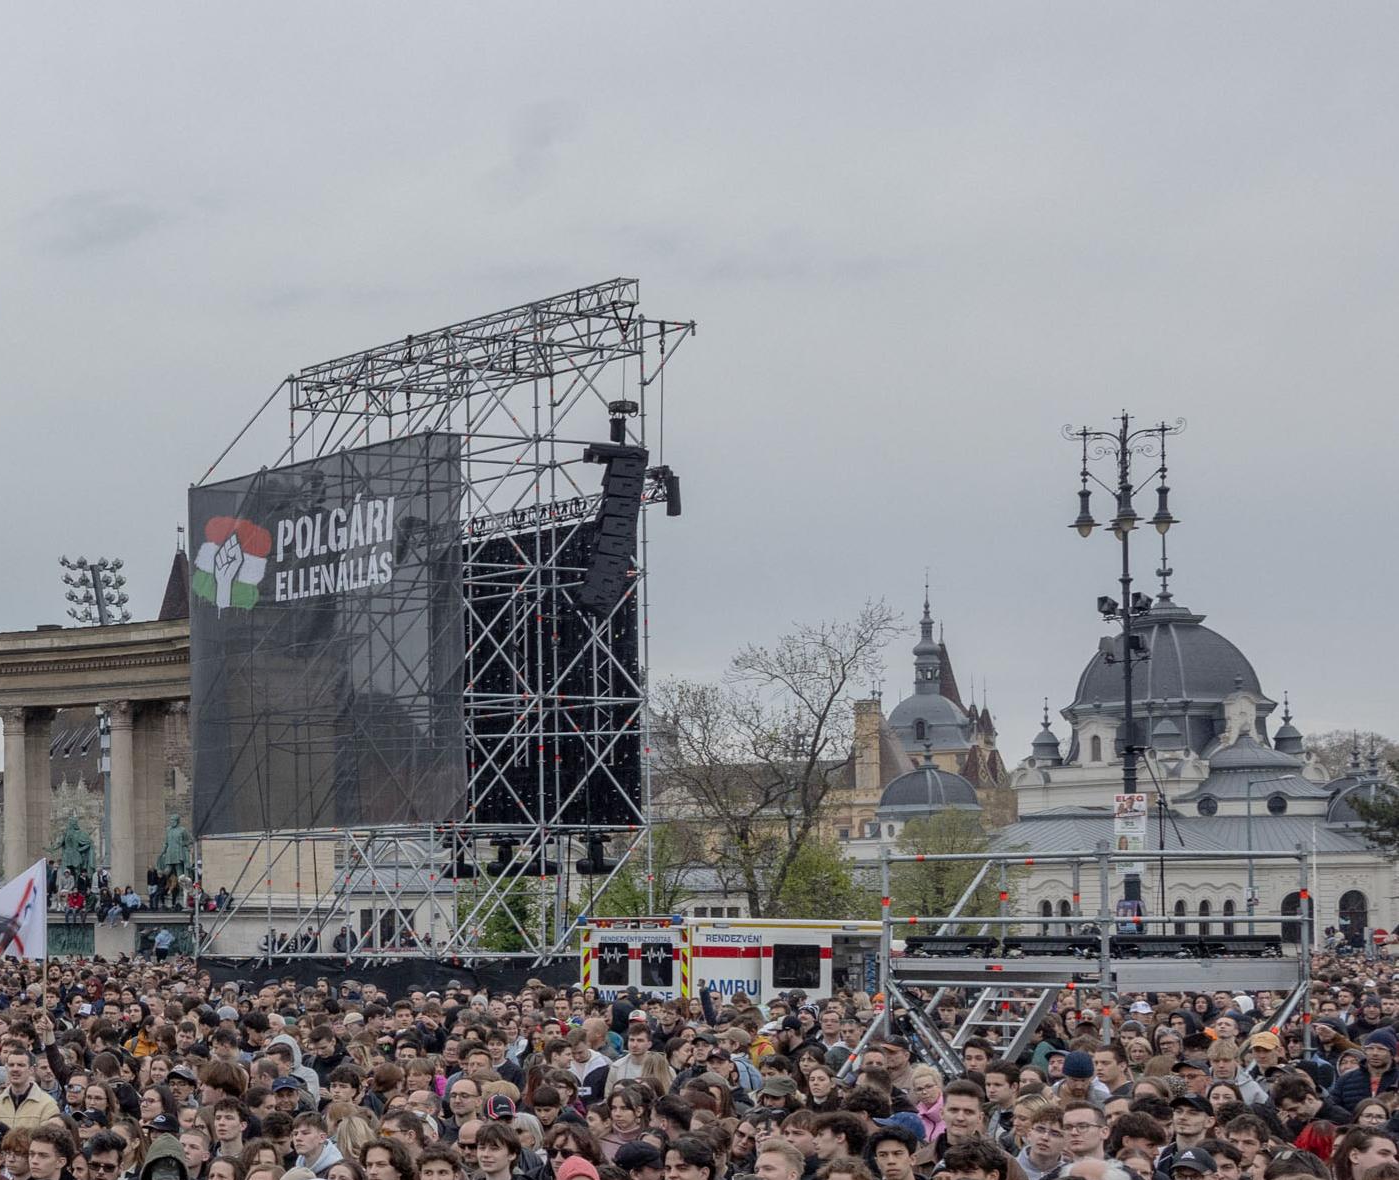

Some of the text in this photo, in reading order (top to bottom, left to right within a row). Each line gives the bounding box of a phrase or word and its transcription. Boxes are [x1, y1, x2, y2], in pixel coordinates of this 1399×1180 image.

[277, 492, 395, 562] POLGÁRI
[275, 546, 393, 602] ELLENÁLLÁS
[706, 933, 762, 943] RENDEZVÉN
